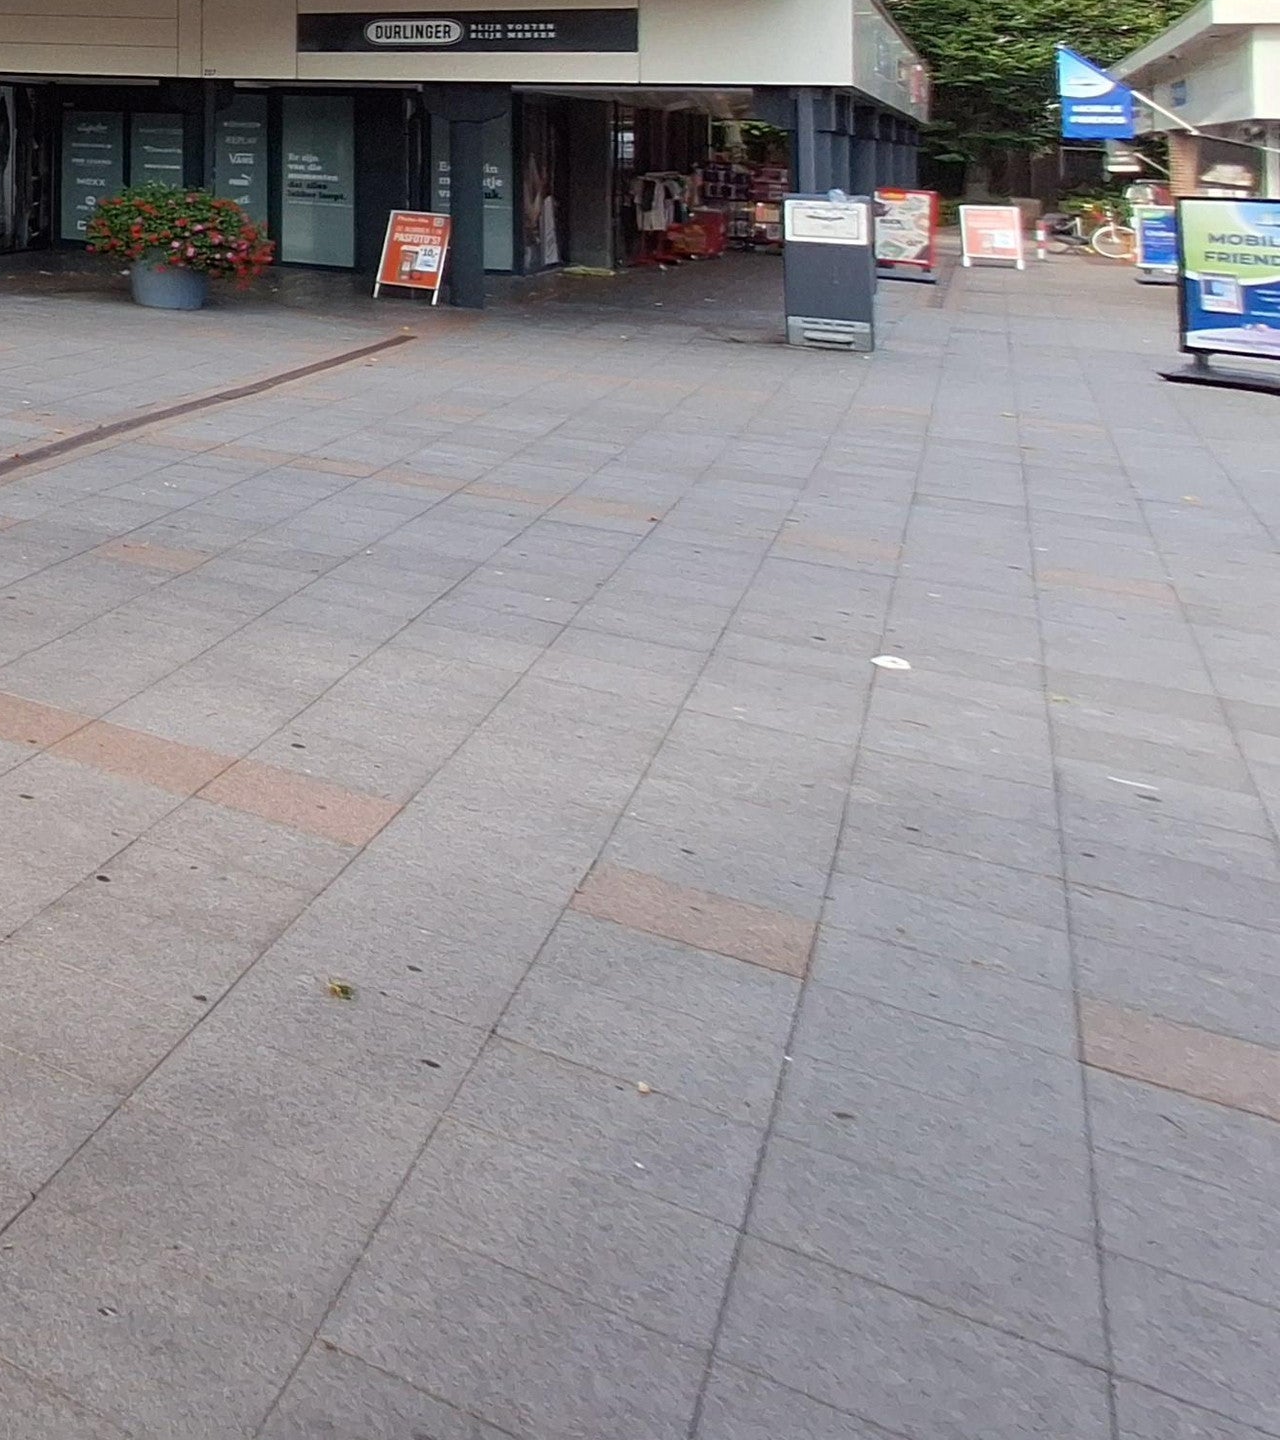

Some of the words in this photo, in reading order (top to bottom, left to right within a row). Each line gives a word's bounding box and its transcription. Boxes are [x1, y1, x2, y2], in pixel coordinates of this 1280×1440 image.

[470, 23, 502, 31] BLIJE
[507, 23, 554, 31] VOETEN
[375, 24, 452, 39] DURLINGER
[470, 32, 502, 40] BLIJE
